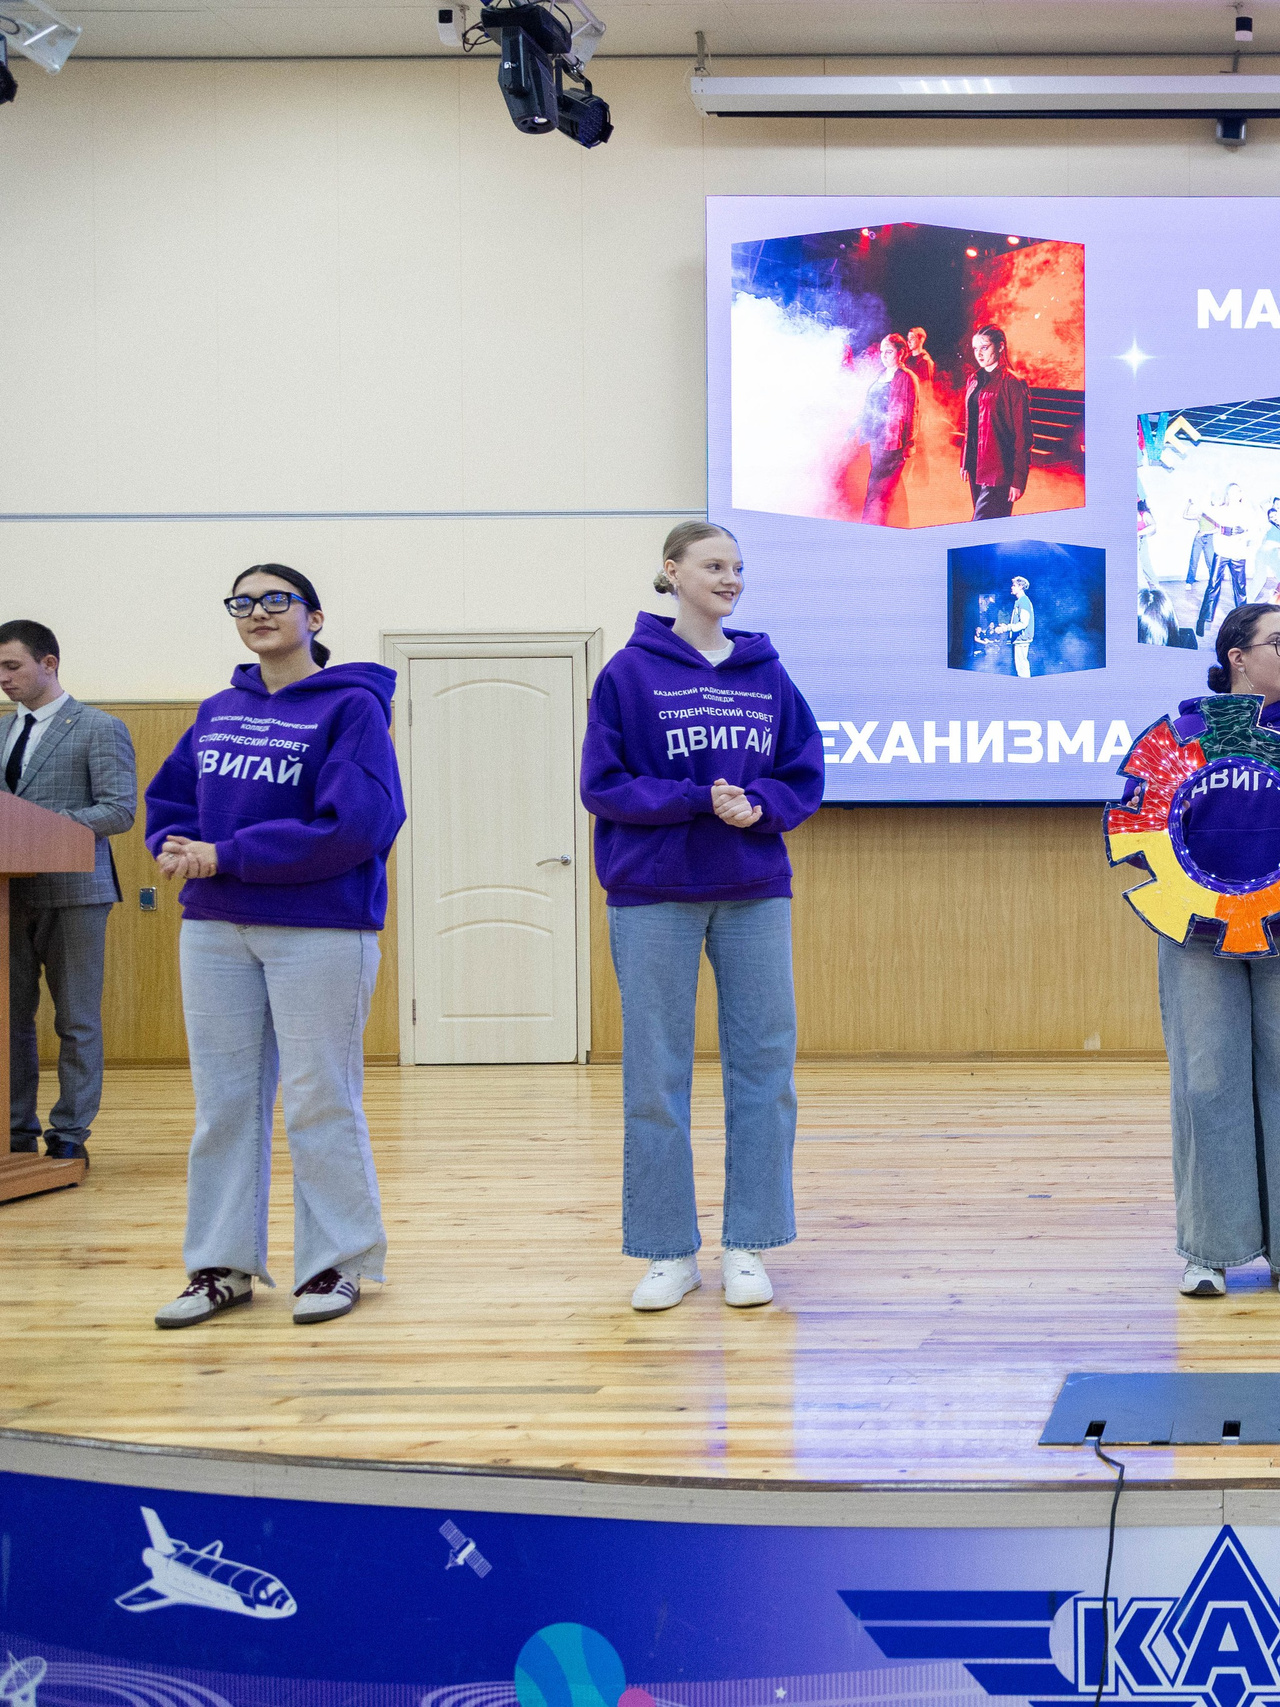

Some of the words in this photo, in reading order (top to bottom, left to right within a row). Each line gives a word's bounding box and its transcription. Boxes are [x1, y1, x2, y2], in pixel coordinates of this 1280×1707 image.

[653, 687, 698, 697] КАЗАНСКИЙ
[699, 686, 773, 700] РАДИОМЕХАНИЧЕСКИЙ
[702, 694, 735, 703] КОЛЛЕДЖ
[658, 706, 744, 720] СТУДЕНЧЕСКИЙ
[745, 710, 774, 723] СОВЕТ
[269, 738, 310, 753] СОВЕТ
[666, 725, 773, 760] ДВИГАЙ
[1191, 767, 1273, 799] ДВИГ
